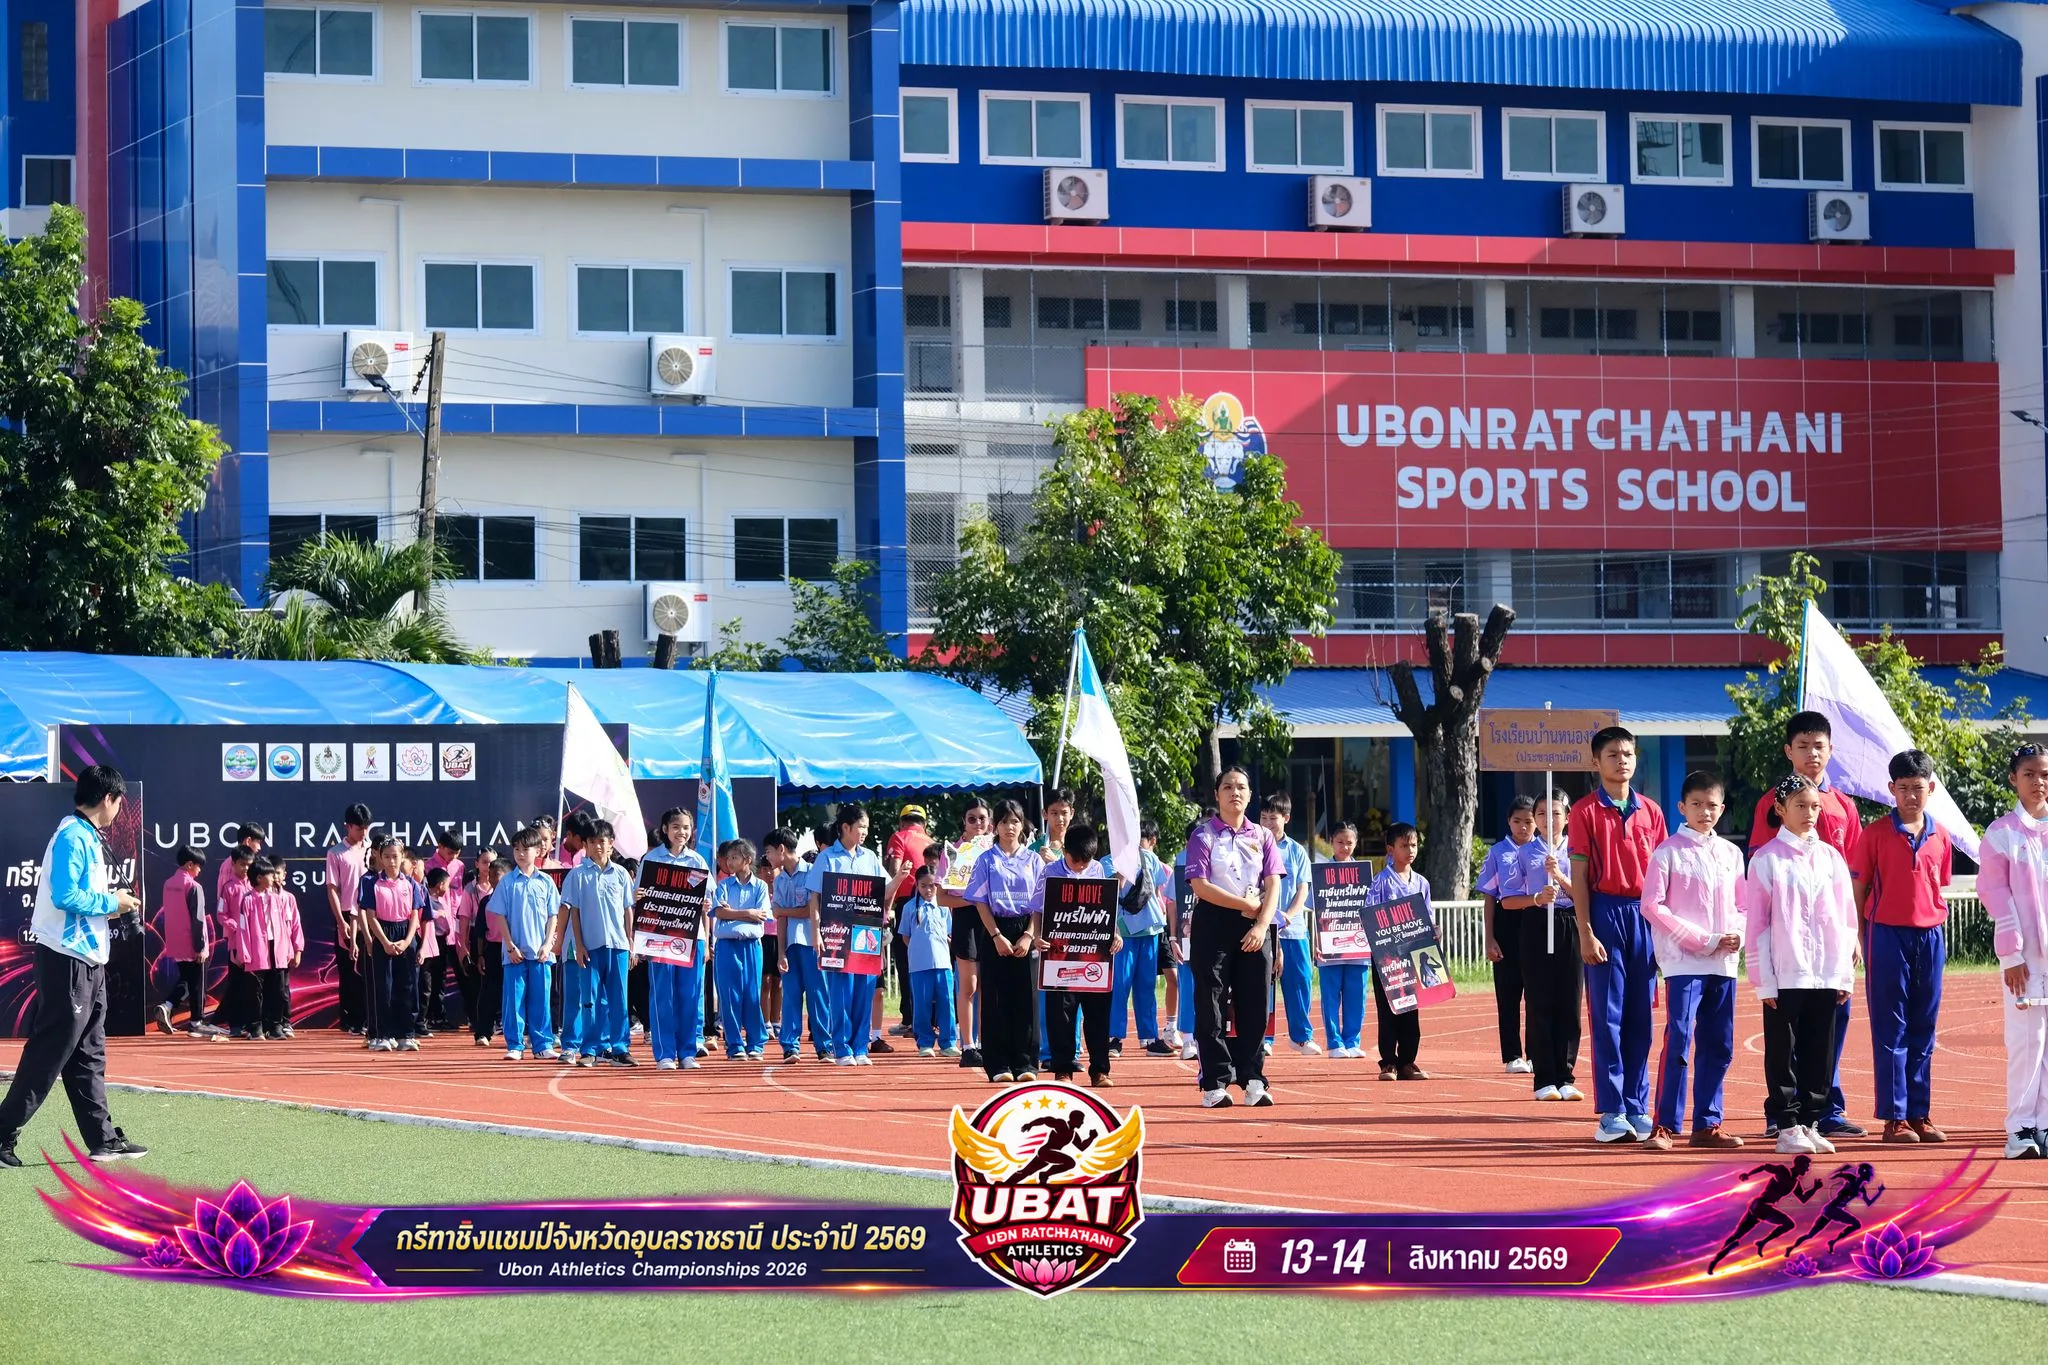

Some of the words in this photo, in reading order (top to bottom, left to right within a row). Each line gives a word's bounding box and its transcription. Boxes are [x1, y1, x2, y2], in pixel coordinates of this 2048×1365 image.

[1336, 404, 1843, 454] UBONRATCHATHANI
[1397, 465, 1589, 511] SPORTS
[1617, 468, 1807, 513] SCHOOL
[655, 867, 669, 885] UB
[670, 869, 693, 890] MOV
[1325, 868, 1336, 885] UB
[1339, 867, 1360, 885] MOVE
[836, 878, 849, 895] UB
[851, 879, 873, 897] MOVE
[1061, 883, 1075, 903] UB
[1077, 884, 1103, 904] MOVE
[830, 894, 847, 902] YOU
[857, 897, 878, 905] MOVE
[1053, 905, 1111, 929] บุหรี่ไฟฟ้า
[1375, 908, 1390, 929] UB
[1389, 901, 1416, 925] MOVE
[1375, 928, 1392, 938] YOU
[1391, 924, 1403, 933] BE
[1402, 918, 1424, 930] MOVE
[1062, 944, 1098, 954] ของชาติ
